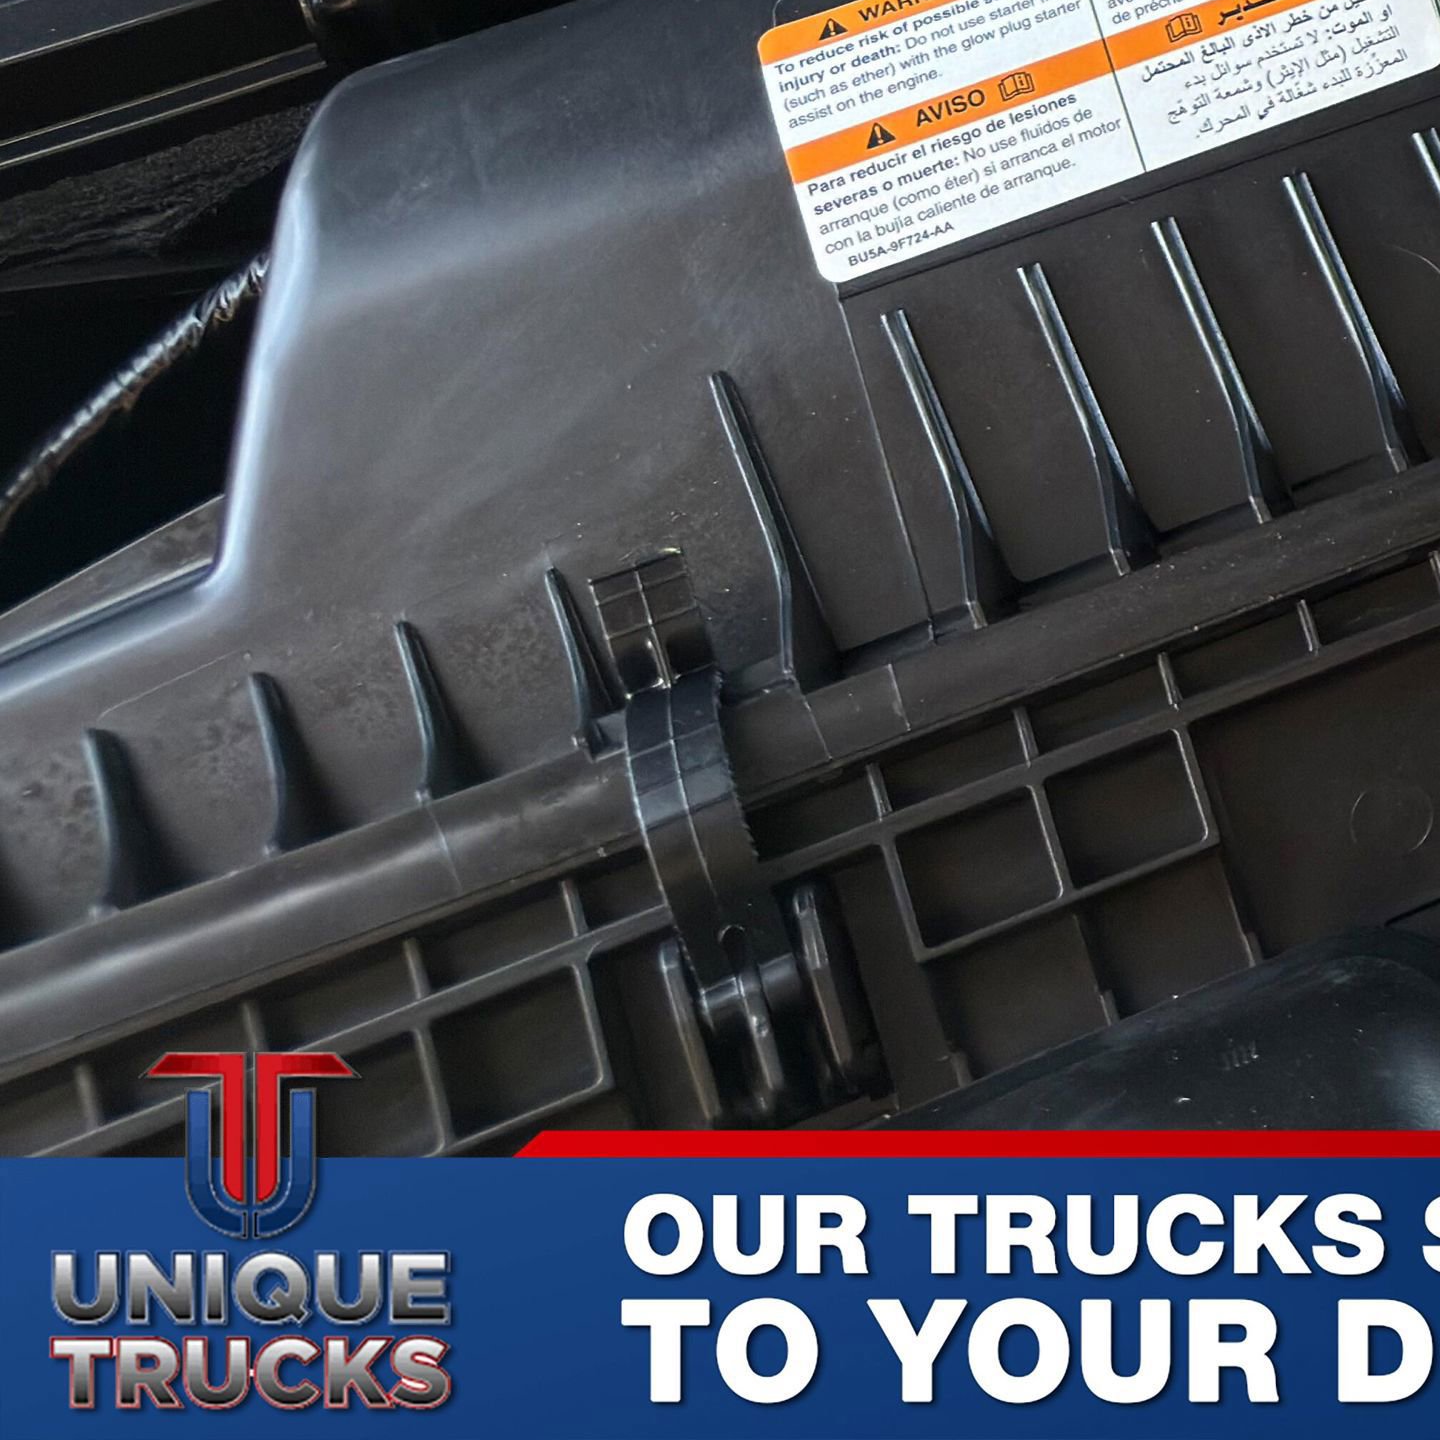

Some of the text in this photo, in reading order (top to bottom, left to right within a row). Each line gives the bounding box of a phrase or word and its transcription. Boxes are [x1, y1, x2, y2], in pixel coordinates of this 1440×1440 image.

[772, 62, 796, 76] To
[798, 41, 855, 69] reduce
[857, 29, 890, 48] risk
[891, 20, 909, 36] of
[777, 68, 826, 93] injury
[828, 61, 847, 76] or
[849, 43, 902, 68] death:
[903, 34, 928, 50] Do
[929, 22, 956, 41] not
[956, 14, 986, 32] use
[782, 87, 827, 113] (such
[828, 80, 849, 96] as
[850, 61, 897, 88] ether)
[897, 50, 931, 71] with
[931, 42, 958, 59] the
[959, 28, 996, 52] glow
[997, 16, 1033, 39] plug
[787, 68, 944, 129] assist on the engine.
[806, 92, 1078, 197] Para reducir el riesgo de lesiones
[915, 87, 986, 128] AVISO
[812, 107, 1093, 216] severas o muerte: No use fluidos de
[818, 117, 1122, 236] arranque (como éter) si arranca el motor
[823, 157, 1077, 255] con la bujía caliente de arranque.
